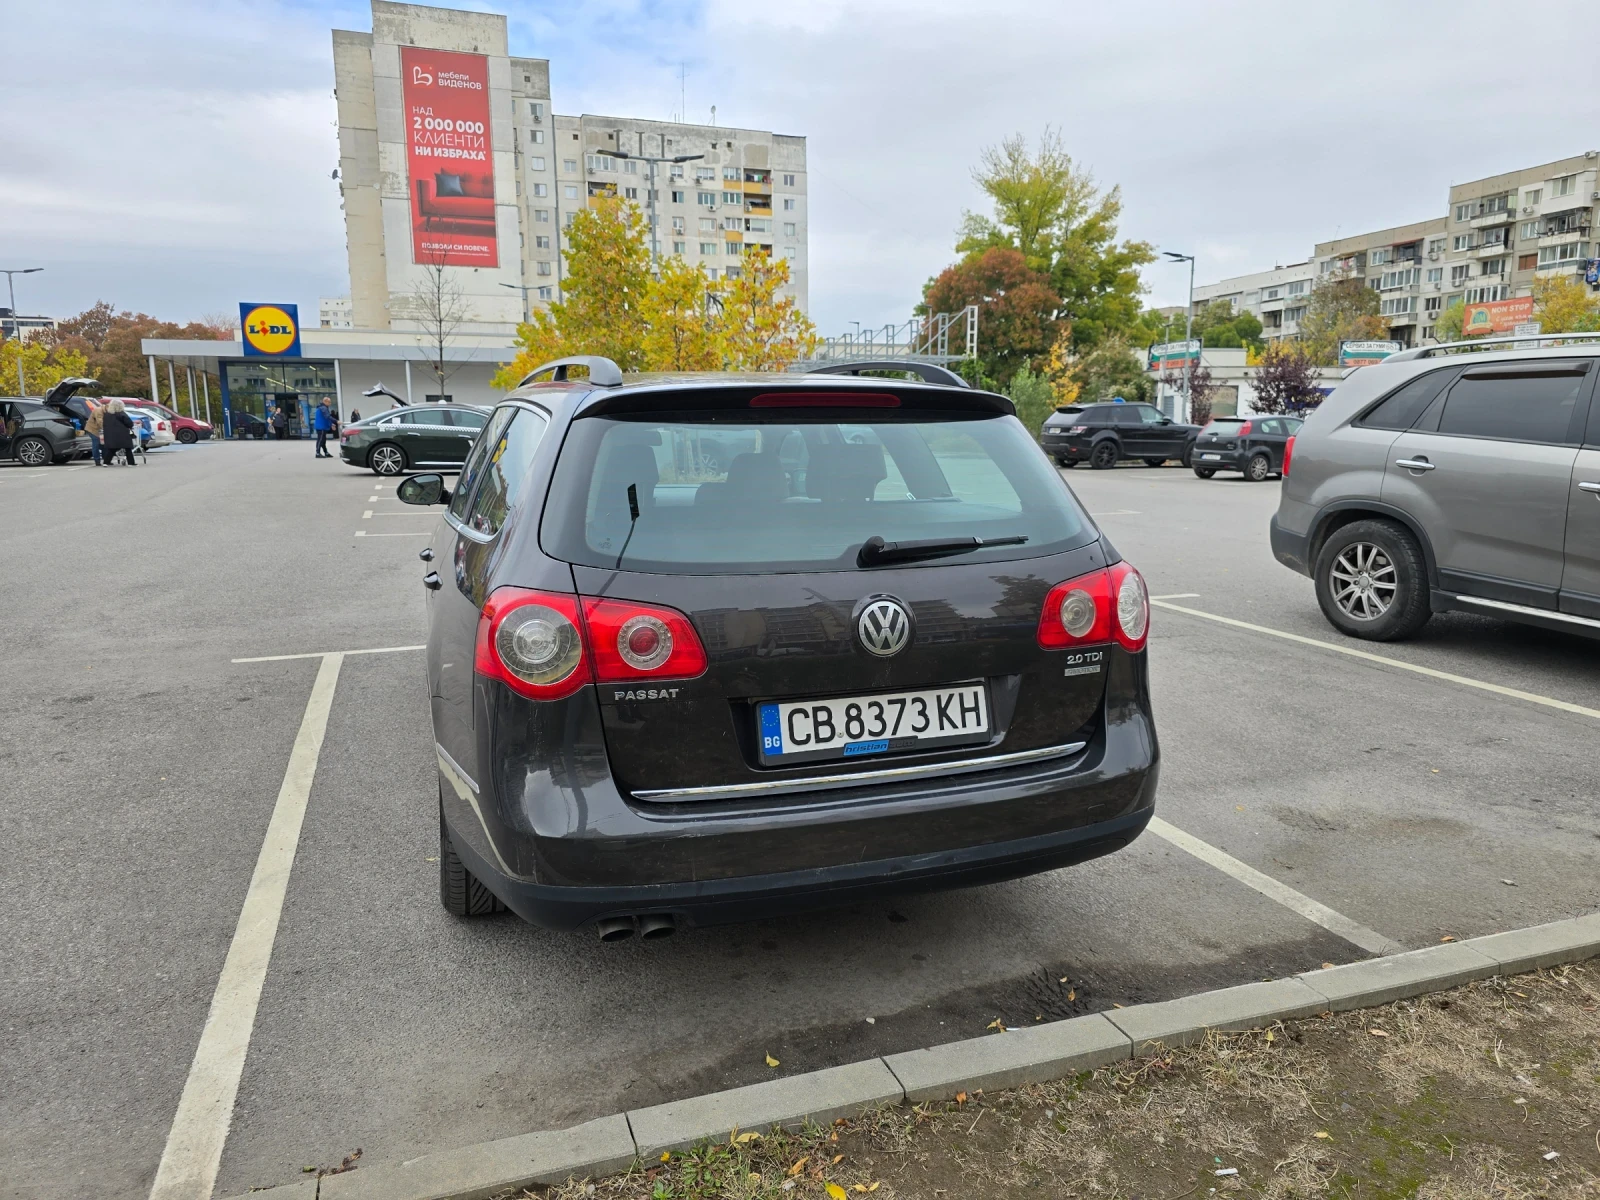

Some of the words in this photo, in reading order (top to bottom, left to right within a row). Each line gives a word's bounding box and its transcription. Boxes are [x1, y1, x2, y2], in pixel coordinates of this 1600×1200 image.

[412, 106, 434, 116] НАД
[413, 116, 422, 129] 2
[424, 117, 454, 132] 000
[456, 120, 484, 134] 000
[414, 131, 484, 149] КЛИЕНТИ
[415, 146, 432, 156] НИ
[421, 242, 453, 250] ПОЗВОЛИ
[1491, 305, 1508, 314] NON
[1509, 303, 1530, 312] STOP
[248, 320, 292, 336] LIDL
[1084, 651, 1103, 662] TDI
[614, 688, 679, 701] PASSAT
[845, 696, 930, 740] 8373
[764, 736, 780, 749] BG
